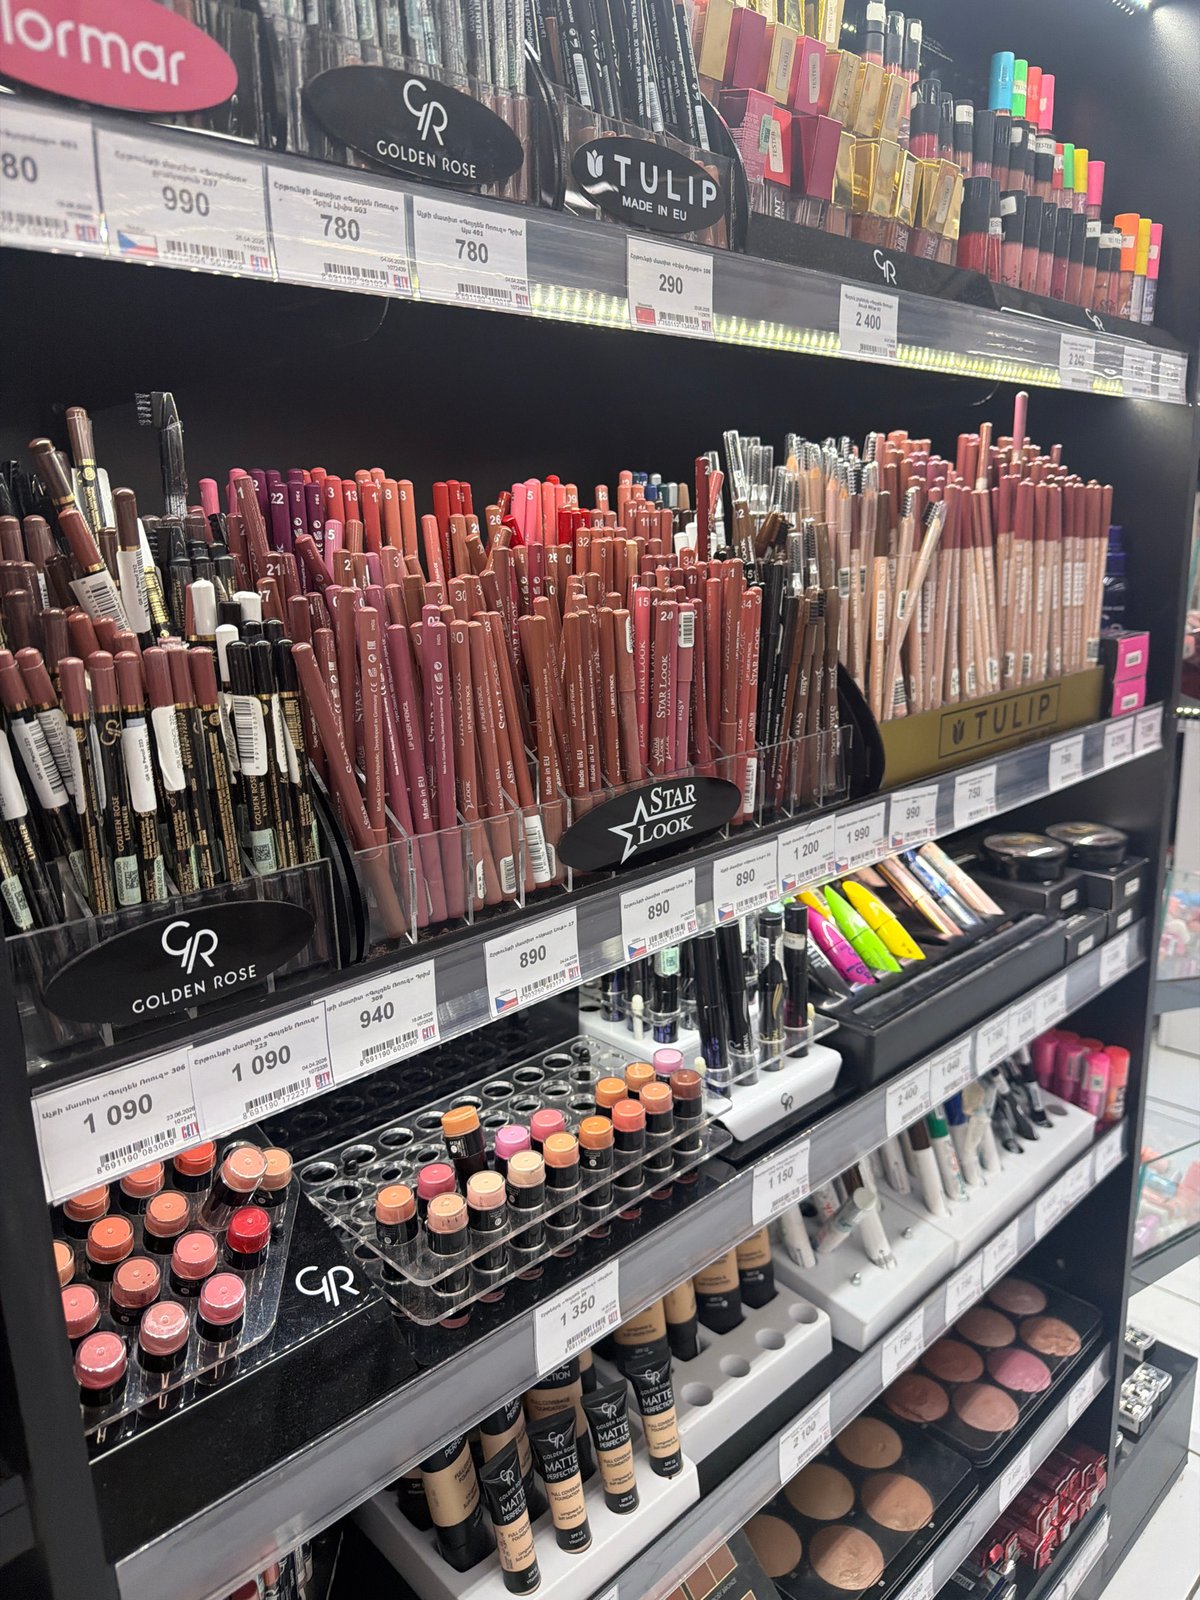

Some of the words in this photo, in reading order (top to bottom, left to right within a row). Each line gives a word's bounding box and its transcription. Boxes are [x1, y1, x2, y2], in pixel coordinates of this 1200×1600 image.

[0, 0, 187, 86] lormar
[1036, 142, 1053, 150] TESTER
[376, 140, 437, 170] GOLDEN
[441, 157, 477, 180] ROSE
[613, 154, 718, 209] TULIP
[162, 185, 210, 217] 990
[622, 194, 654, 214] MADE
[657, 205, 669, 218] IN
[673, 208, 688, 222] EU
[320, 213, 360, 242] 780
[455, 238, 488, 264] 780
[659, 274, 683, 294] 290
[856, 311, 862, 326] 2
[864, 314, 881, 330] 400
[752, 626, 760, 659] LOOK
[750, 661, 758, 686] STAR
[400, 700, 413, 723] PENCIL
[656, 690, 667, 718] STAR
[975, 693, 1051, 740] TULIP
[404, 723, 415, 740] LINER
[407, 740, 416, 751] LIP
[576, 749, 584, 760] EU
[543, 755, 550, 766] EU
[588, 755, 595, 763] in
[416, 775, 426, 788] EU
[577, 769, 587, 788] Made
[588, 764, 598, 782] Made
[420, 789, 427, 797] in
[545, 776, 553, 795] Made
[112, 796, 121, 817] ROSE
[420, 798, 432, 820] Made
[650, 783, 697, 815] STAR
[122, 805, 130, 841] LIPLINER
[905, 806, 921, 820] 990
[115, 818, 125, 852] GOLDEN
[637, 814, 694, 847] LOOK
[847, 832, 851, 843] 1
[854, 825, 870, 842] 990
[19, 823, 36, 860] LIPLINER
[794, 847, 798, 860] 1
[802, 840, 819, 857] 200
[736, 868, 755, 886] 890
[648, 899, 670, 920] 890
[520, 945, 546, 968] 890
[131, 980, 206, 1015] GOLDEN
[213, 964, 257, 989] ROSE
[360, 1002, 394, 1028] 940
[255, 1041, 267, 1050] 223
[364, 1049, 390, 1064] 691190
[391, 1037, 417, 1053] 603090
[171, 1064, 186, 1074] 306
[232, 1063, 242, 1082] 1
[252, 1045, 290, 1075] 090
[242, 1112, 248, 1120] 8
[248, 1100, 278, 1117] 691190
[280, 1086, 309, 1103] 172237
[83, 1113, 96, 1134] 1
[107, 1094, 152, 1126] 090
[103, 1152, 138, 1171] 691190
[140, 1137, 174, 1156] 083069
[775, 1166, 794, 1184] 150
[560, 1312, 566, 1326] 1
[572, 1295, 595, 1319] 350
[643, 1389, 672, 1407] MATTE
[598, 1421, 629, 1441] MATTE
[542, 1449, 562, 1460] GOLDEN
[543, 1452, 577, 1473] MATTE
[546, 1463, 579, 1481] PERFECTION
